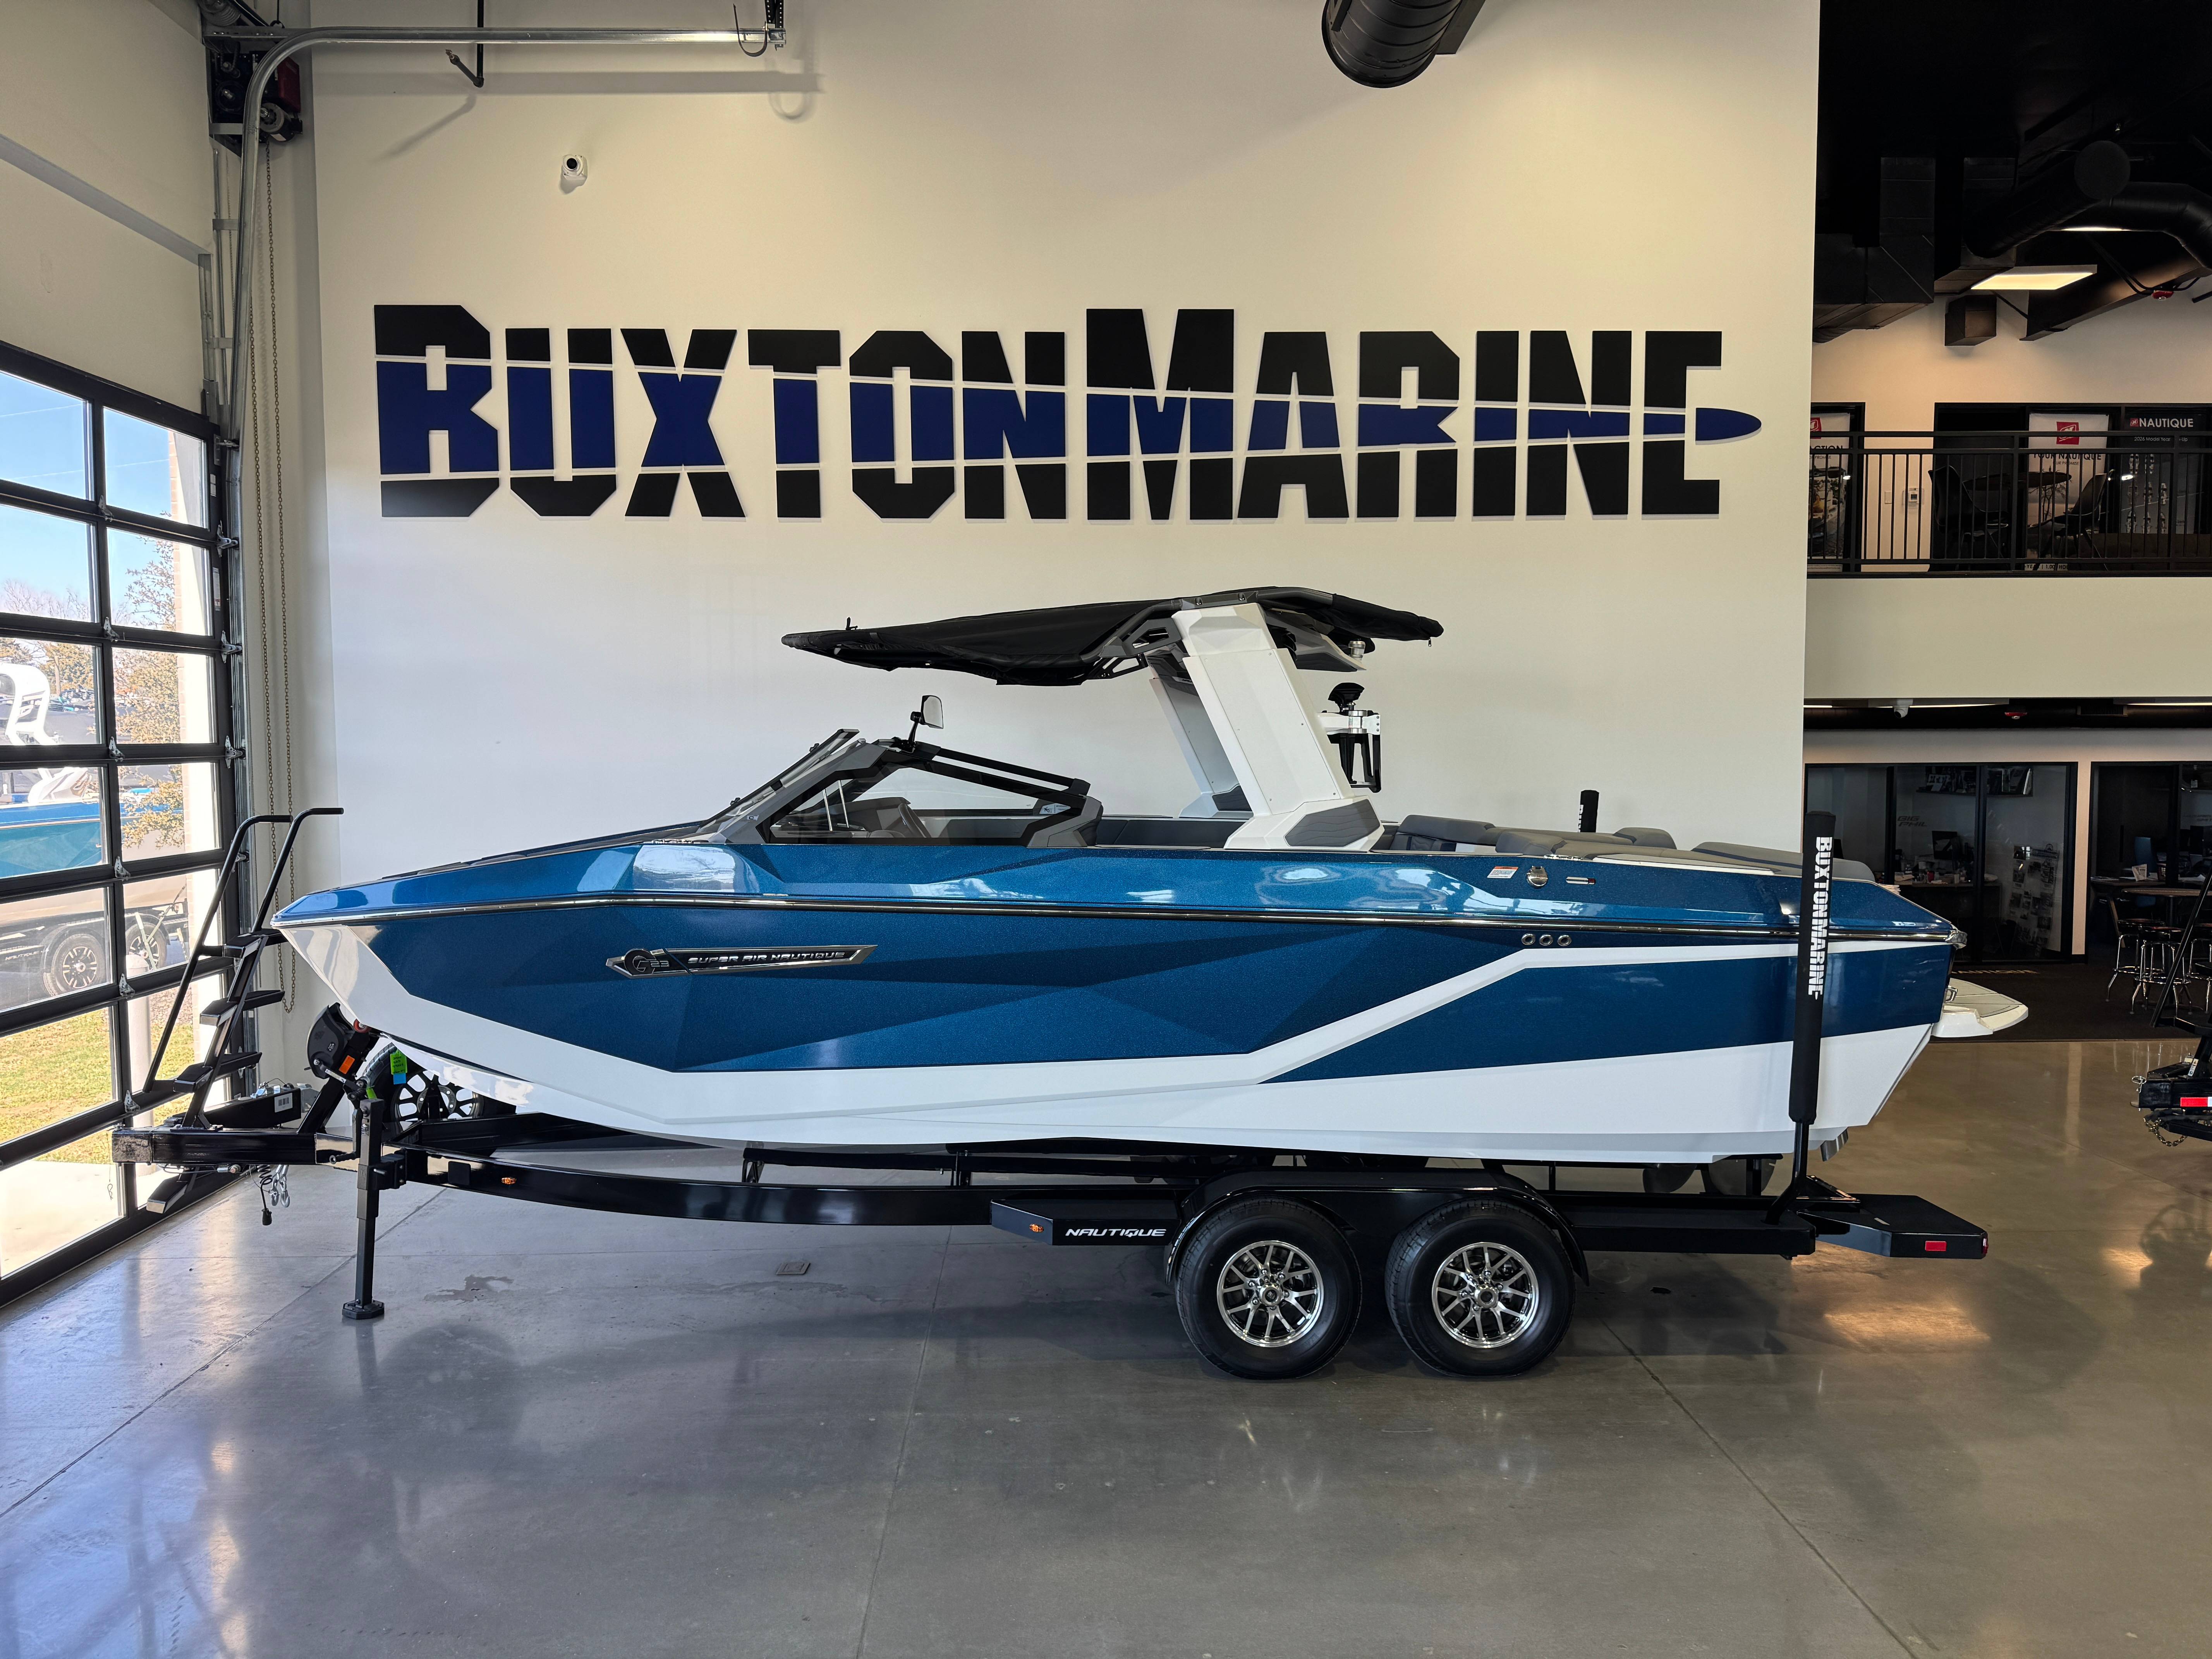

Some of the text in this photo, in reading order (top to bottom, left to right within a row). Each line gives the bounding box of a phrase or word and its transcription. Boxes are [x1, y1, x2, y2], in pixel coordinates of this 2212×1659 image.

[2139, 418, 2193, 428] NAUTIQUE
[771, 951, 846, 961] NAUTIQUE
[1065, 1228, 1167, 1238] NAUTIQUE
